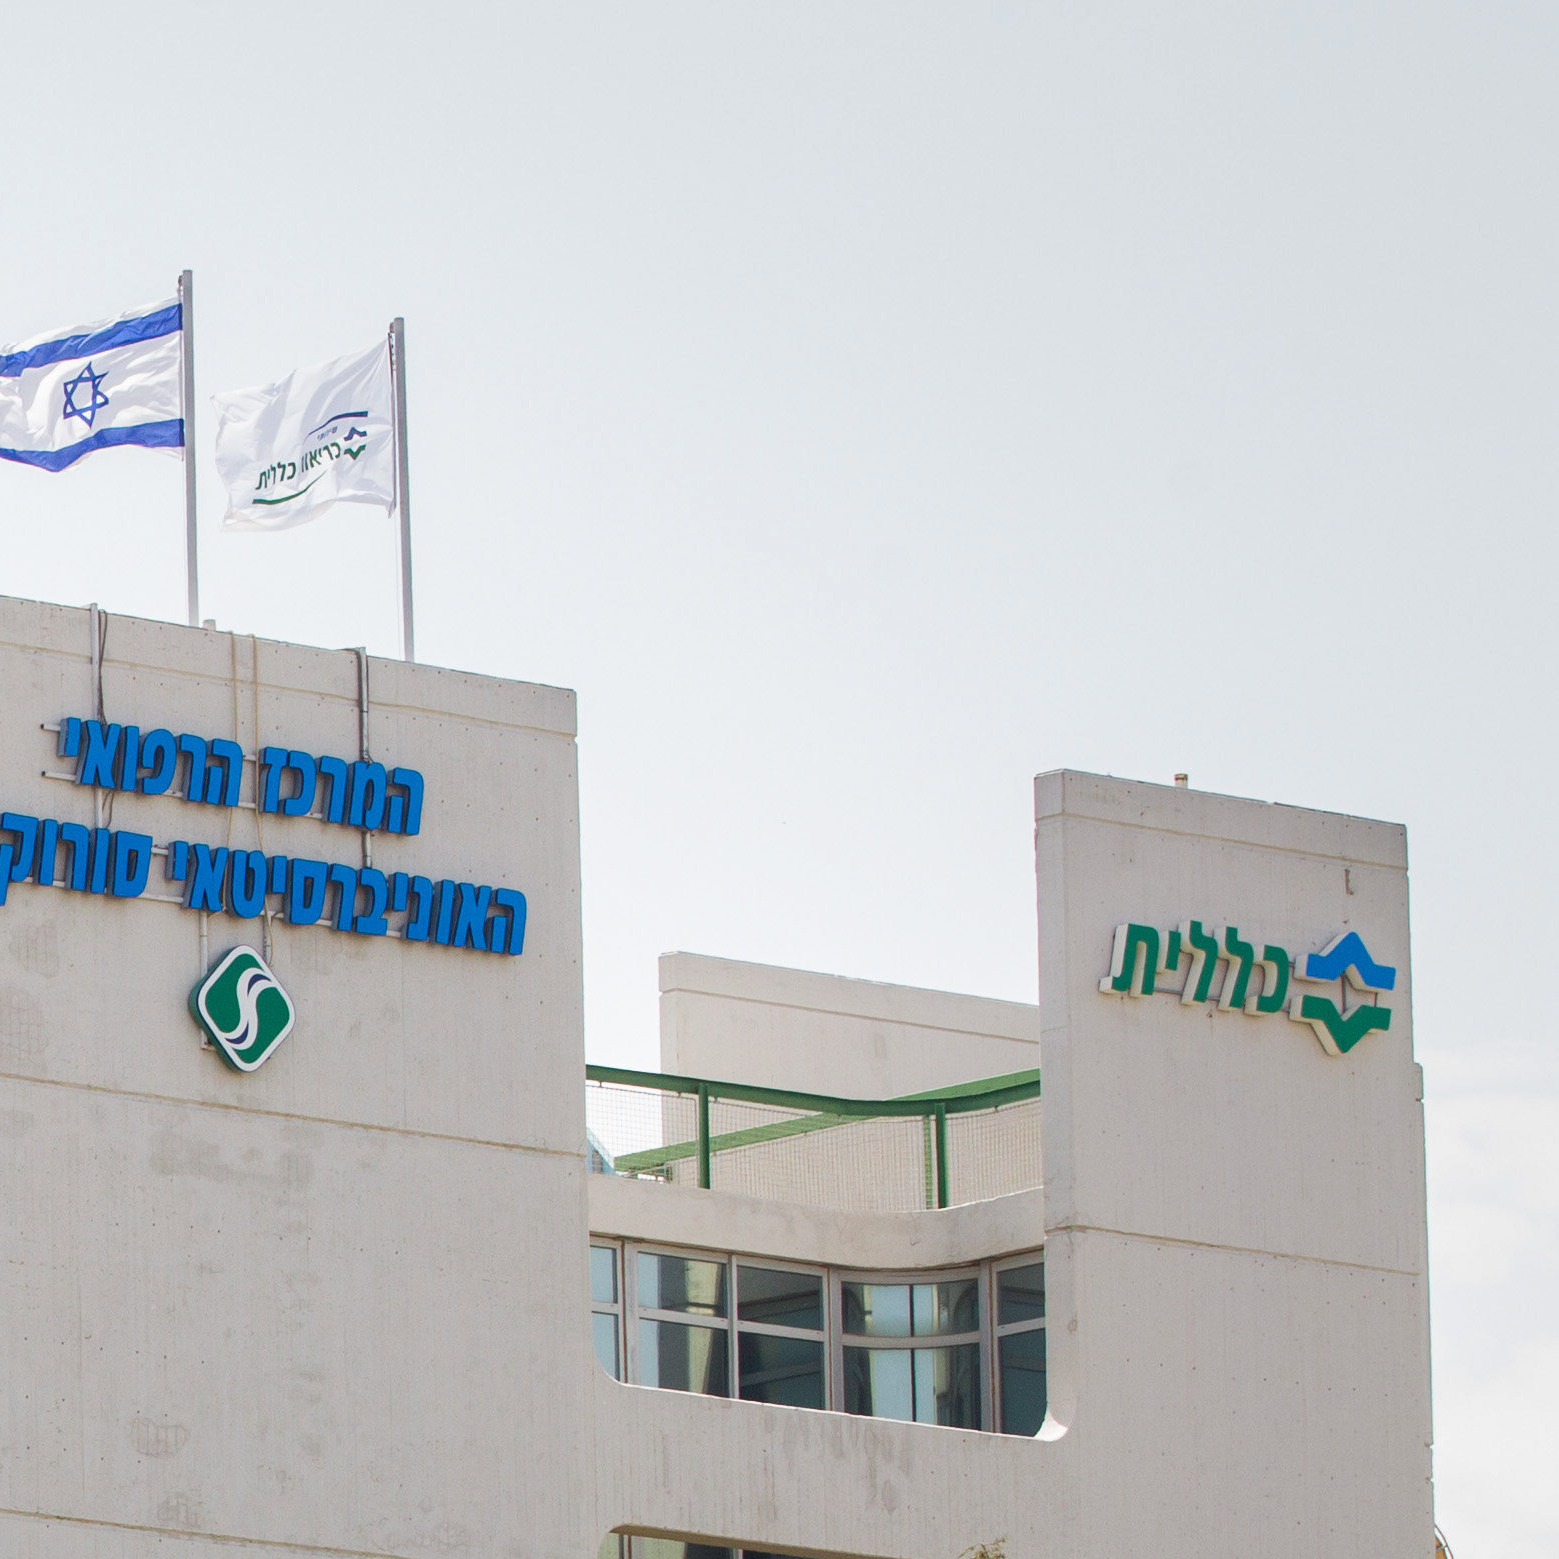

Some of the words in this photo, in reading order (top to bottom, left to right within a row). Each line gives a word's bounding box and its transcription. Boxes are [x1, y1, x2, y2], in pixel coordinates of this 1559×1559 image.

[255, 460, 297, 490] כללית
[61, 716, 244, 807] הרפואי
[260, 745, 425, 836] המרכז
[168, 840, 528, 955] האוניברסיטאי
[1106, 919, 1290, 1015] כללית
